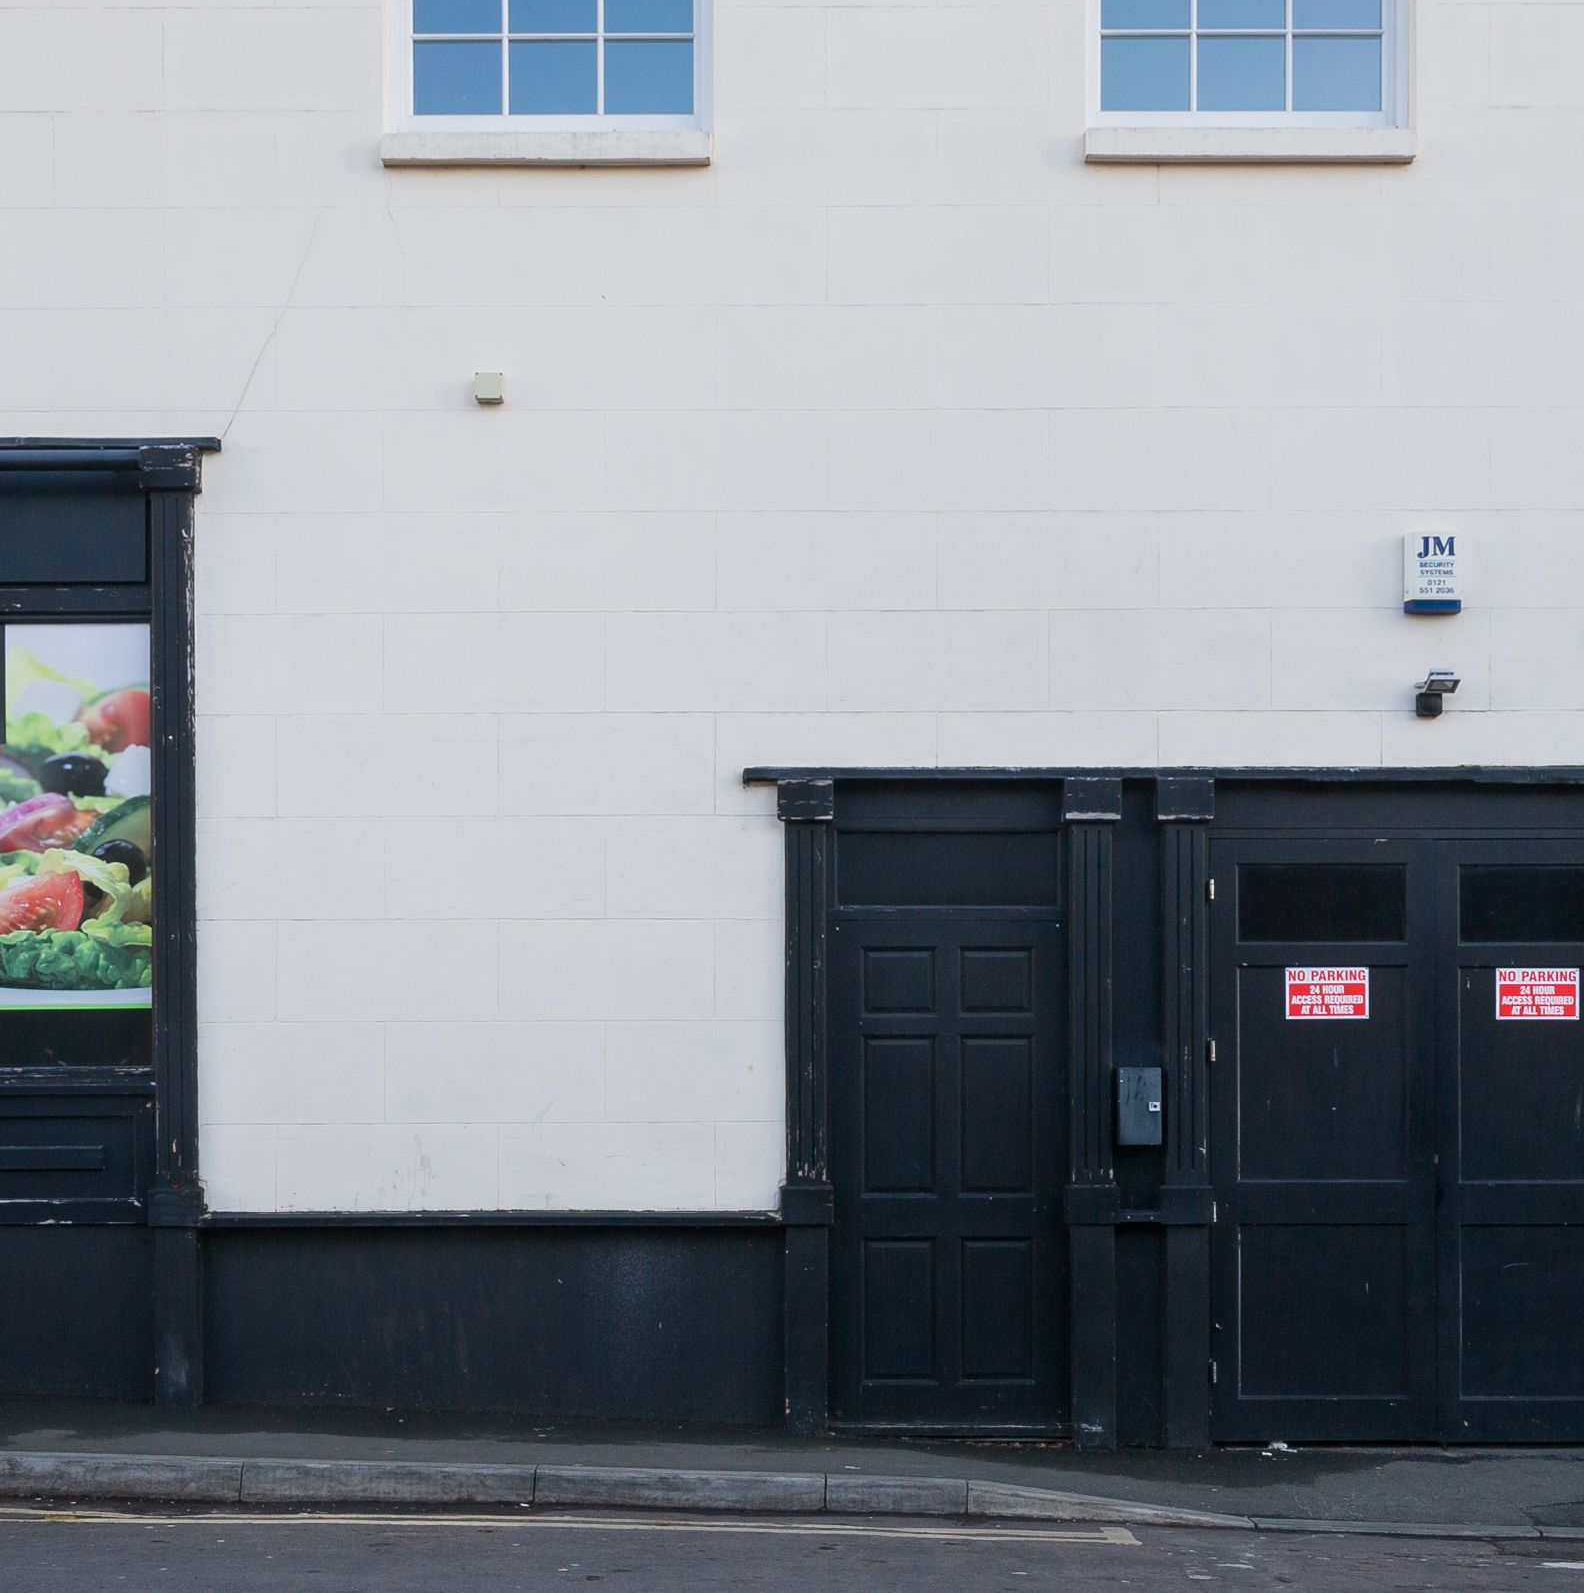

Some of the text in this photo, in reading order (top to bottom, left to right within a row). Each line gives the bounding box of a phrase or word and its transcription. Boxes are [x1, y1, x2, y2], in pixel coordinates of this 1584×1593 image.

[1417, 536, 1456, 559] JM
[1288, 970, 1366, 981] NO PARKING
[1499, 971, 1576, 982] NO PARKING
[1309, 985, 1345, 994] 24 HOUR
[1520, 986, 1555, 994] 24 HOUR
[1291, 995, 1363, 1004] ACCESS REQUIRED
[1502, 996, 1574, 1005] ACCESS REQUIRED
[1301, 1005, 1354, 1014] AT ALL TIMES
[1511, 1006, 1565, 1015] AT ALL TIMES
